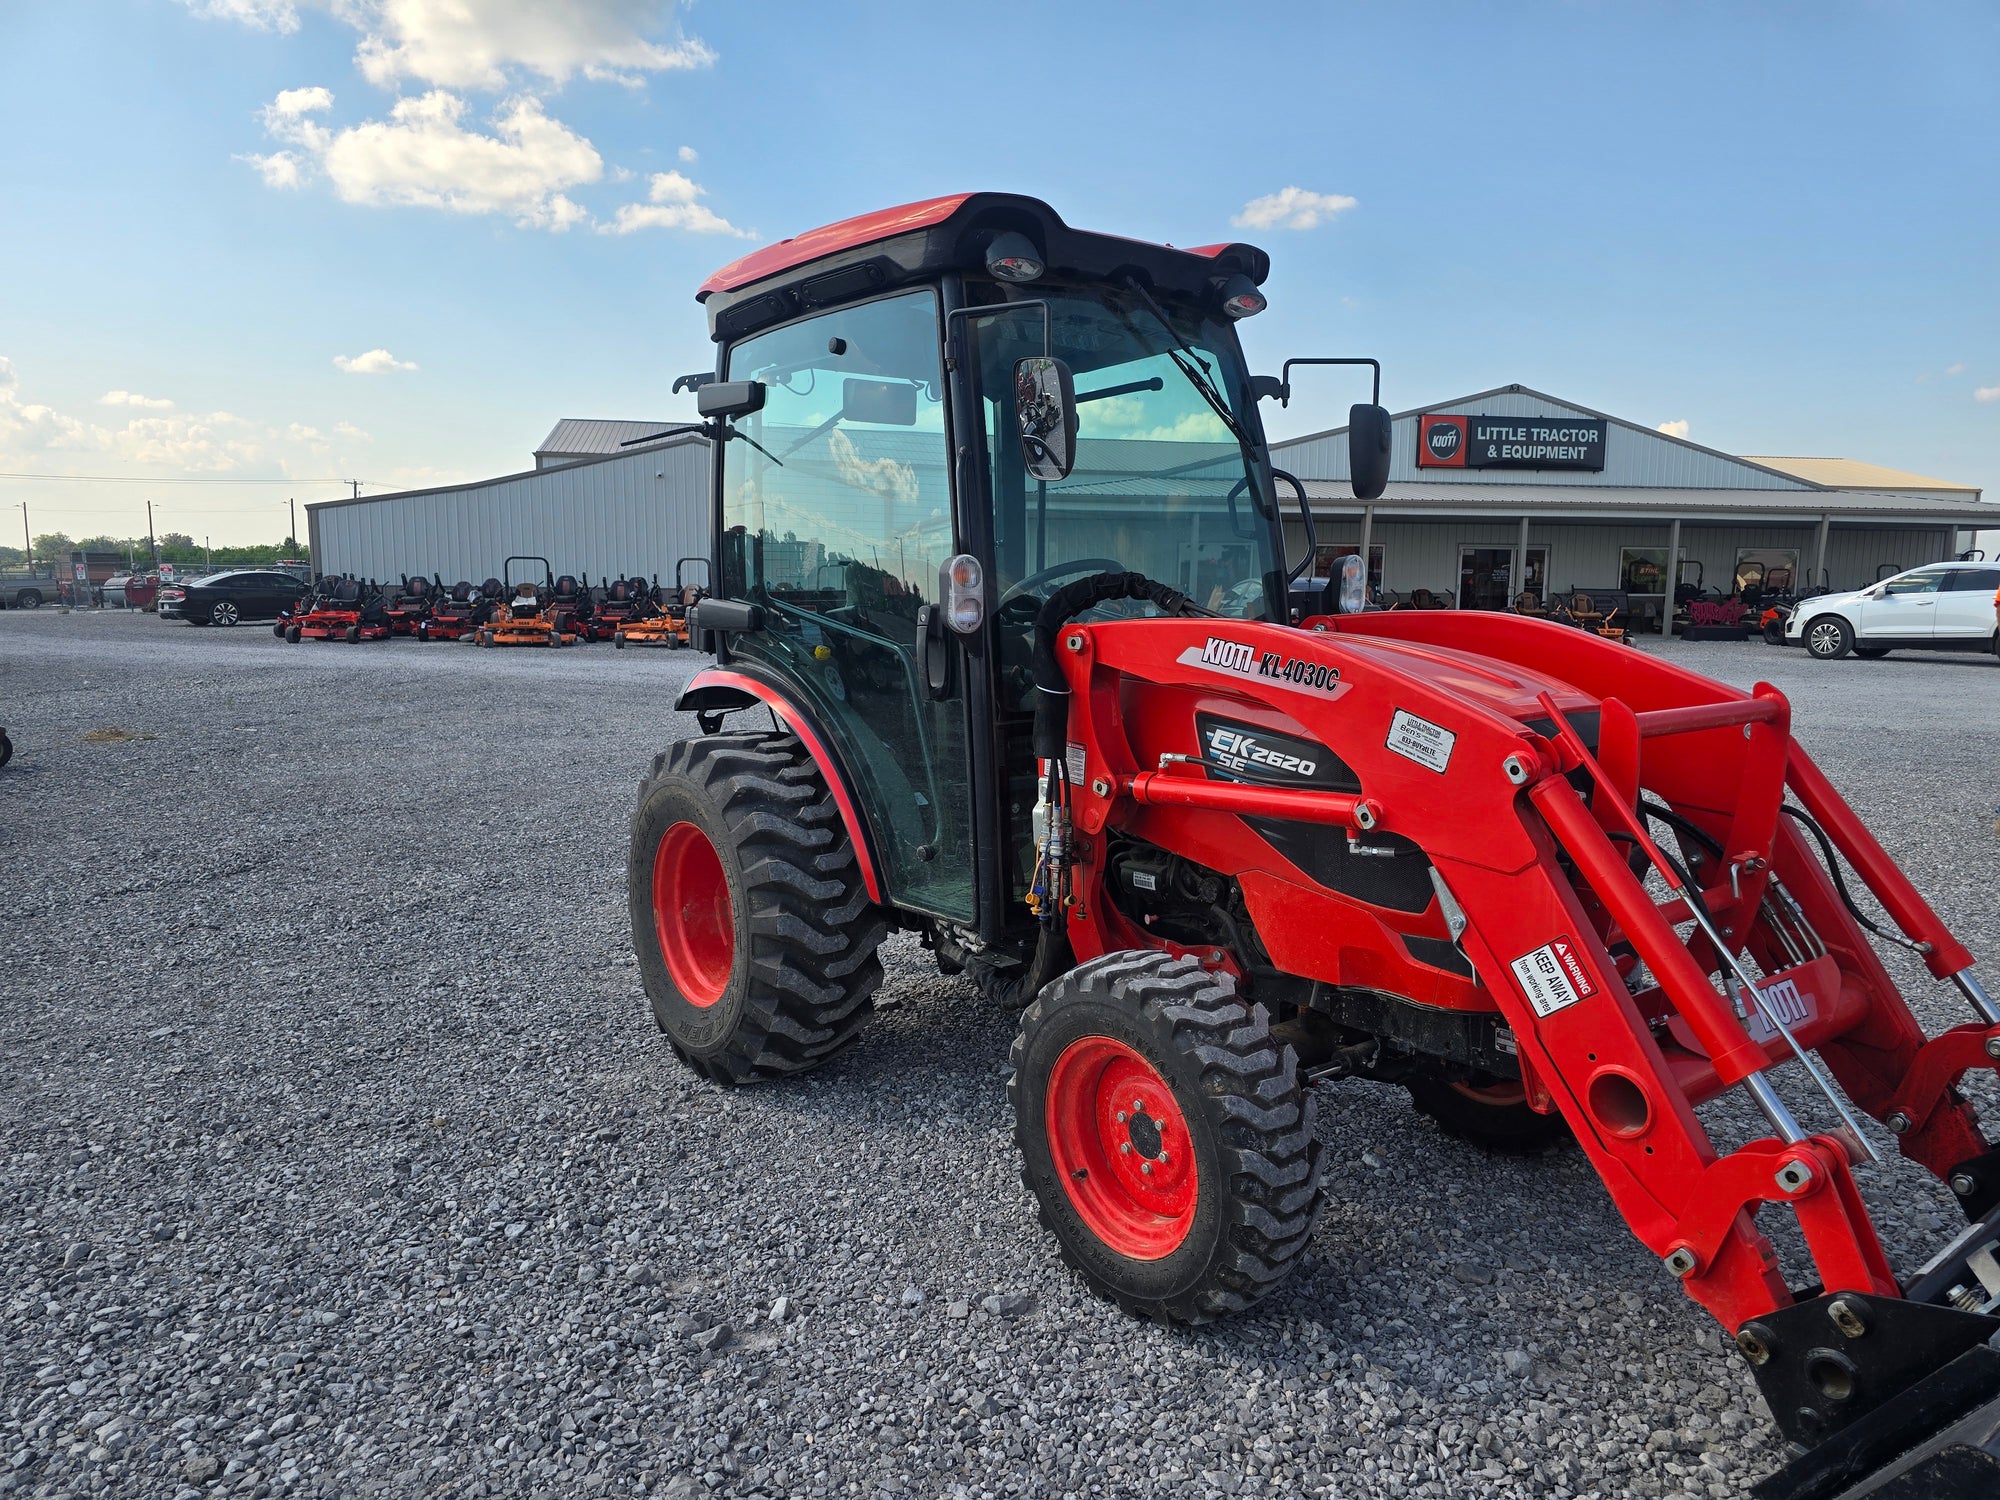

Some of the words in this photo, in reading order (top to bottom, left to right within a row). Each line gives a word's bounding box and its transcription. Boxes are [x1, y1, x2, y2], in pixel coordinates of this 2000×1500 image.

[1432, 435, 1457, 447] KIOTI
[1477, 427, 1527, 440] LITTLE
[1531, 428, 1598, 443] TRACTOR
[1487, 444, 1498, 458] &
[1502, 445, 1587, 460] EQUIPMENT
[1201, 636, 1255, 673] KIOTI
[1258, 652, 1339, 693] KL4030C
[1217, 752, 1248, 772] SE
[1519, 959, 1531, 975] from
[1526, 974, 1544, 999] working
[1540, 998, 1552, 1012] area
[1533, 950, 1555, 974] KEEP
[1546, 976, 1571, 1003] AWAY
[1563, 952, 1591, 994] WARNING
